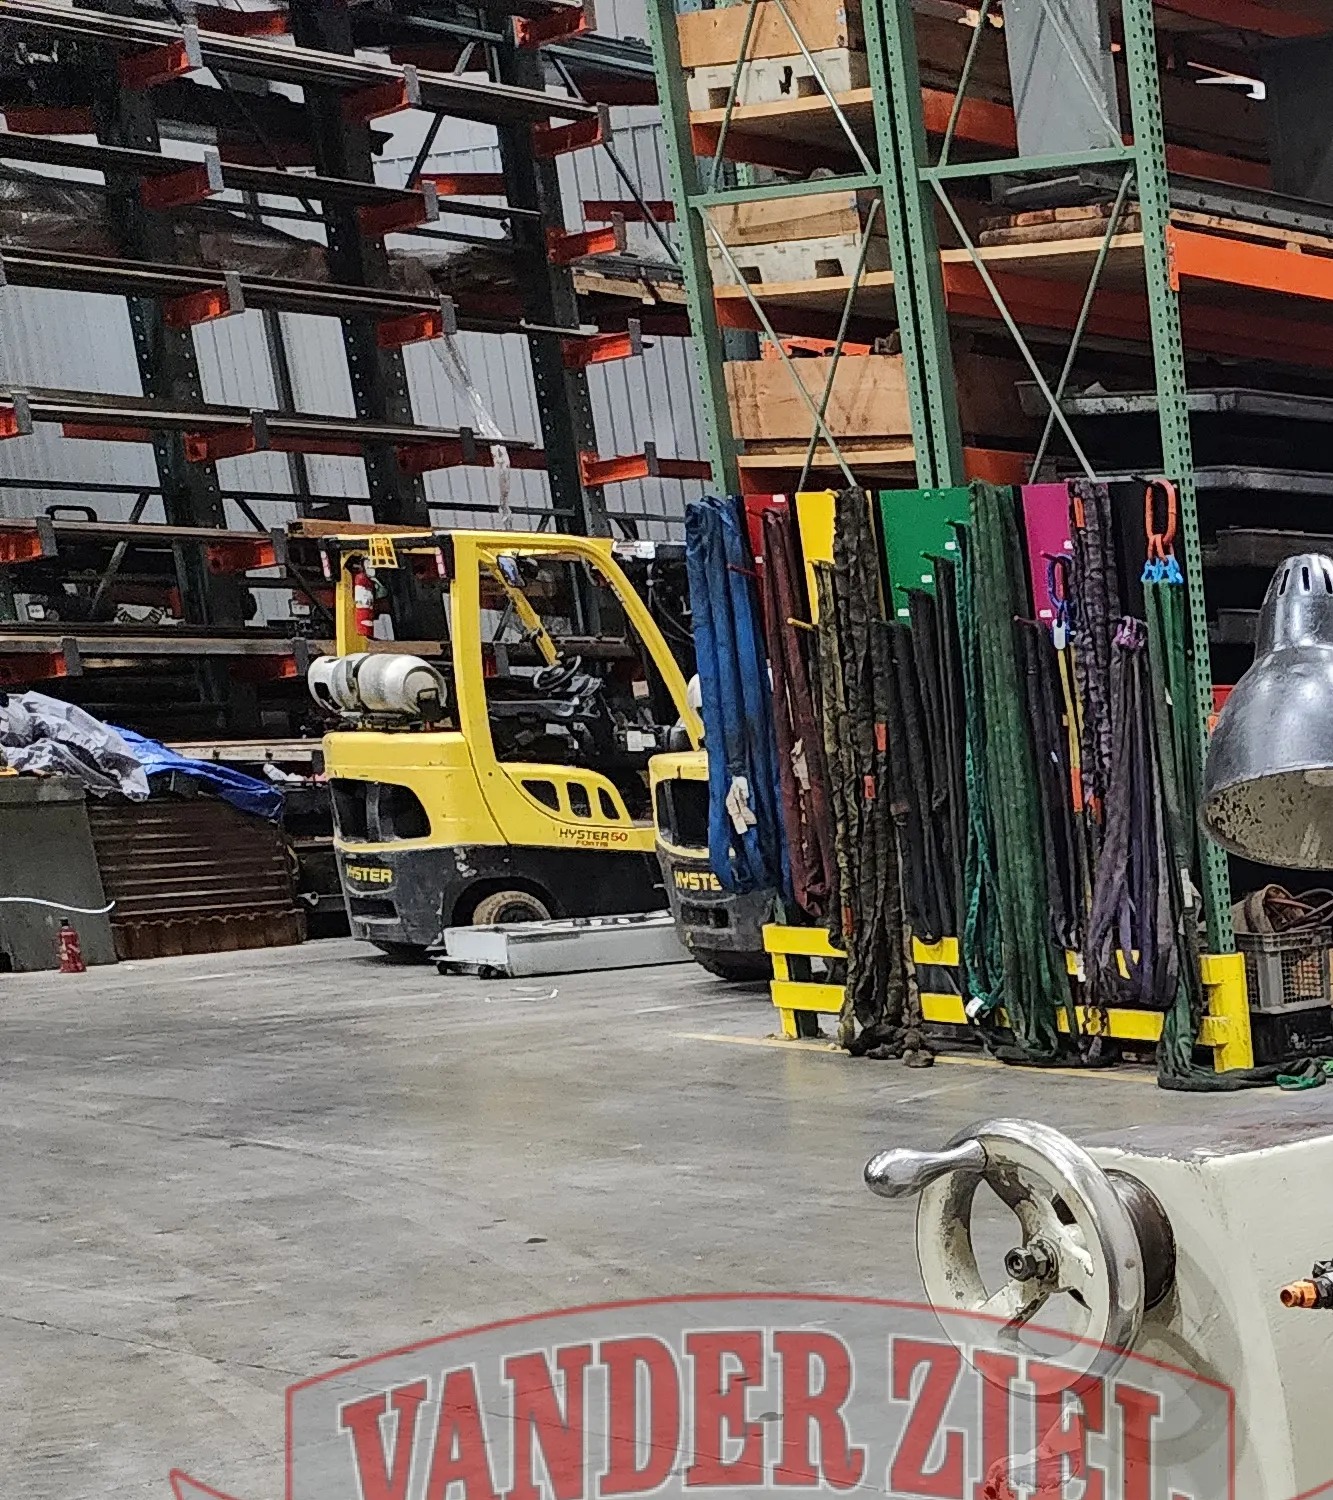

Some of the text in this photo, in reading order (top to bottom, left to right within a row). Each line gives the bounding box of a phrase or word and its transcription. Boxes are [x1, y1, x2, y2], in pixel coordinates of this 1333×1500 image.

[559, 828, 629, 842] HYSTER 50
[674, 870, 723, 891] HYSTE
